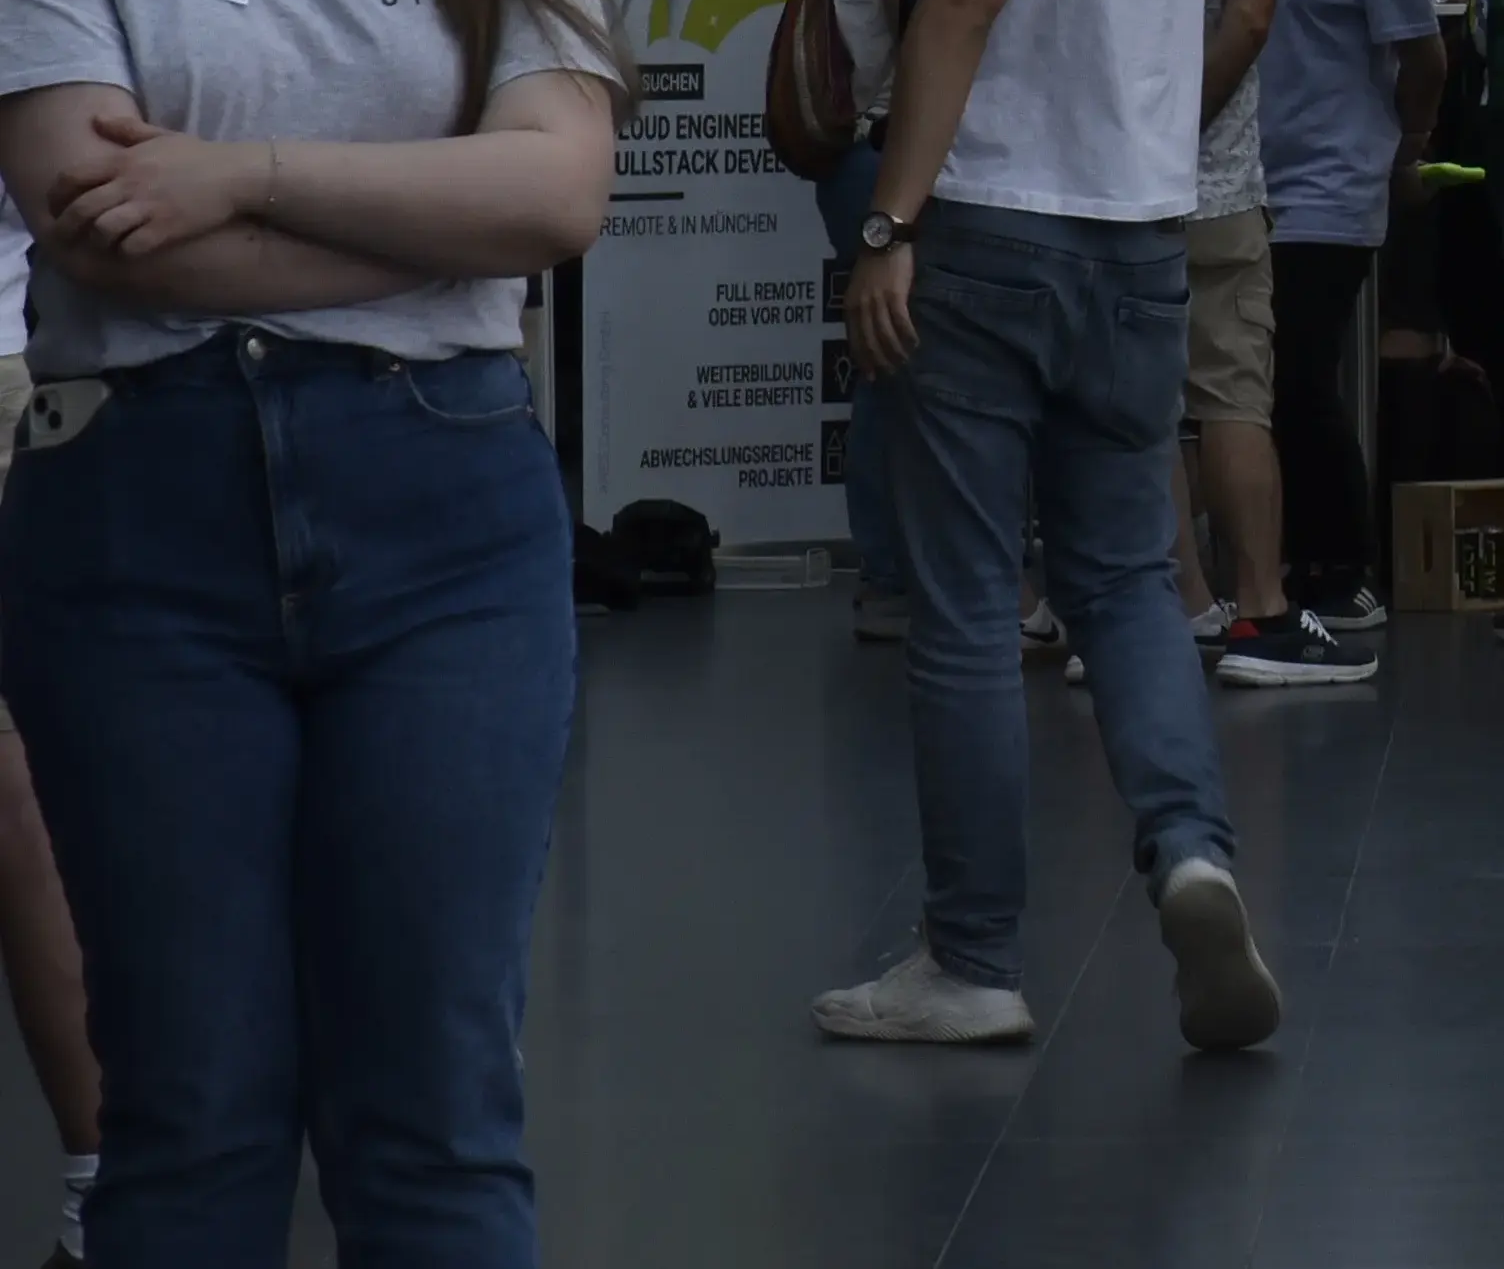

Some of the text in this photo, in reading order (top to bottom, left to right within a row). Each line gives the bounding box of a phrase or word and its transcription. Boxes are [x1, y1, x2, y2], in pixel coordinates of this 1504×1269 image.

[642, 72, 700, 92] SUCHEN
[618, 114, 671, 141] LOUD
[615, 149, 719, 176] ULLSTACK
[600, 210, 778, 237] REMOTE & IN MÜNCHEN
[716, 281, 815, 302] FULL REMOTE
[708, 305, 814, 326] ODER VOR ORT
[696, 362, 814, 384] WEITERBILDUNG
[687, 386, 814, 409] & VIELE BENEFITS
[639, 442, 814, 469] ABWECHSLUNGSREICHE
[738, 466, 814, 488] PROJEKTE
